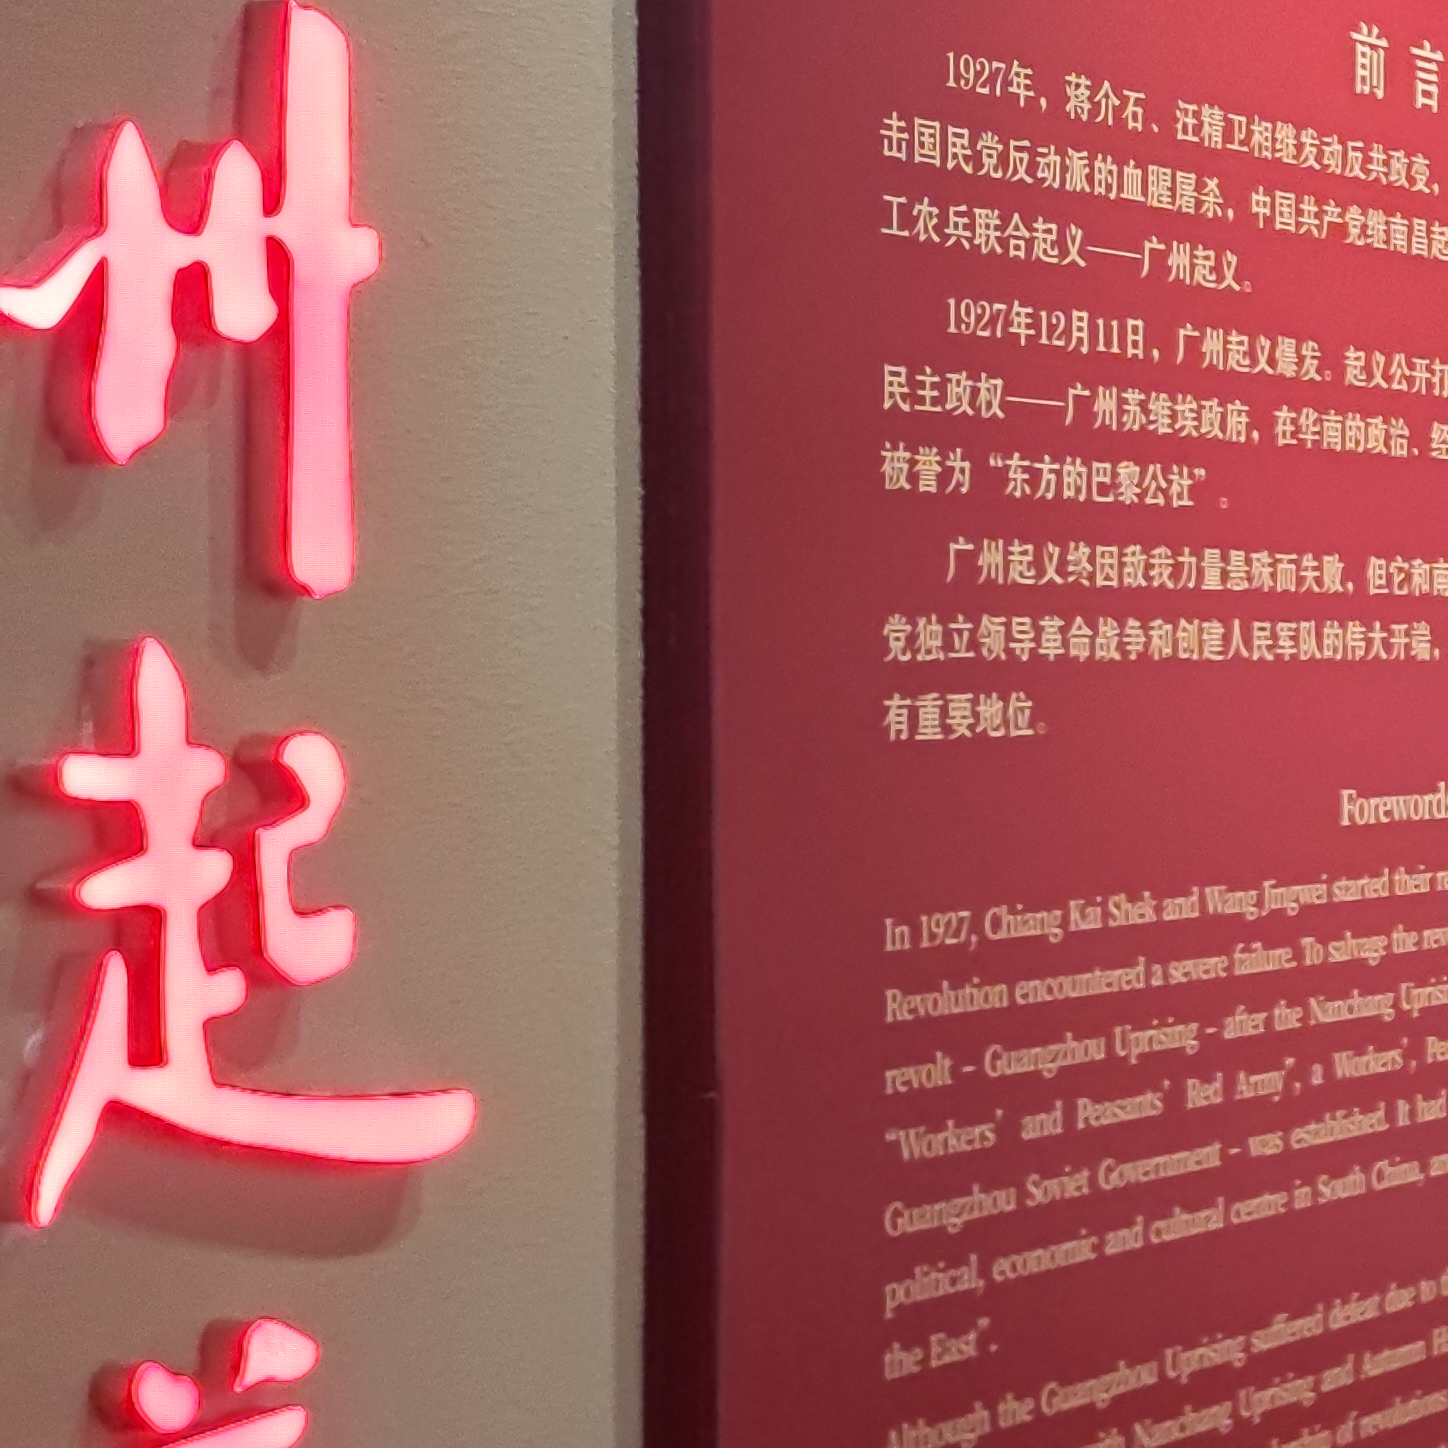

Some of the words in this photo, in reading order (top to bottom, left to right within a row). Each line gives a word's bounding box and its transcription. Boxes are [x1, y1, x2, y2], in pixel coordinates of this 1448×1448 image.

[1349, 20, 1446, 114] 前言
[882, 691, 1048, 742] 有重要地位。
[885, 917, 910, 951] In
[984, 903, 1063, 943] Chiang
[1069, 896, 1102, 931] Kai
[1108, 891, 1156, 927] Shek
[1162, 886, 1200, 920] and
[1204, 885, 1258, 920] Wang
[1261, 873, 1327, 915] Jingwei
[1331, 867, 1389, 902] started
[1393, 864, 1433, 895] their
[885, 976, 1008, 1022] Revolution
[1015, 956, 1145, 1004] encountered
[1150, 963, 1163, 986] a
[1168, 955, 1228, 984] severe
[1300, 936, 1323, 965] To
[1327, 930, 1387, 966] salvage
[885, 1051, 952, 1094] revolt
[984, 1032, 1105, 1078] Guangzhou
[1114, 1017, 1199, 1064] Uprising
[1223, 1004, 1268, 1039] after
[1273, 1000, 1303, 1030] the
[1308, 988, 1394, 1025] Nanchang
